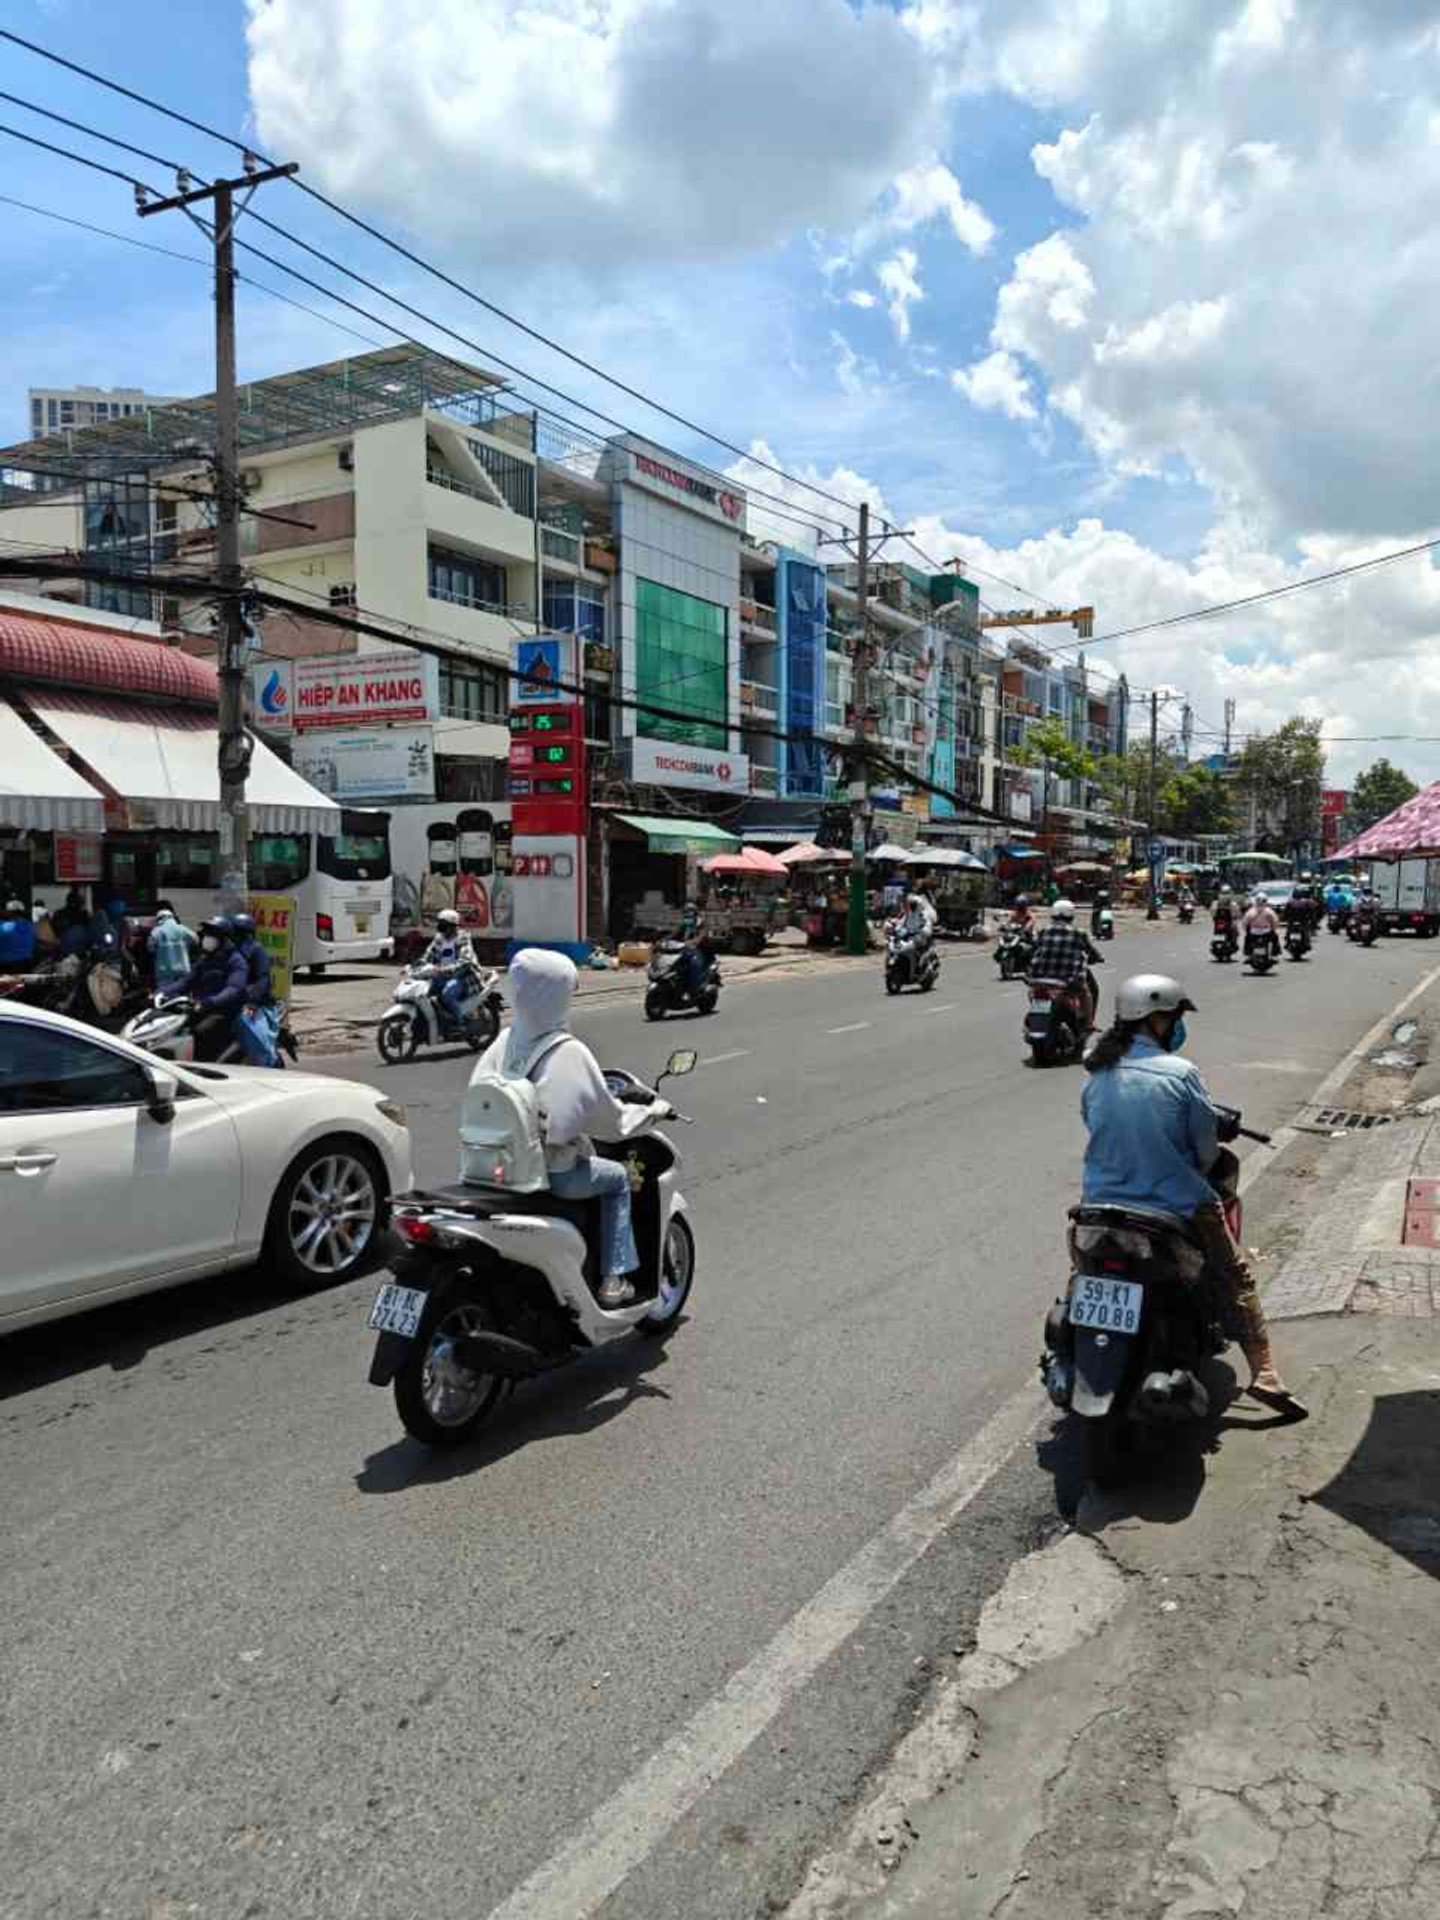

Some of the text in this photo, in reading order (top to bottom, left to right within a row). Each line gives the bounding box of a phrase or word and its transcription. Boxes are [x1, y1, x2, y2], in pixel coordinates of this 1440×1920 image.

[337, 683, 361, 704] AN
[364, 678, 423, 703] KHANG
[655, 755, 716, 775] TECHCOMBANK
[1083, 1280, 1130, 1307] 59-K1
